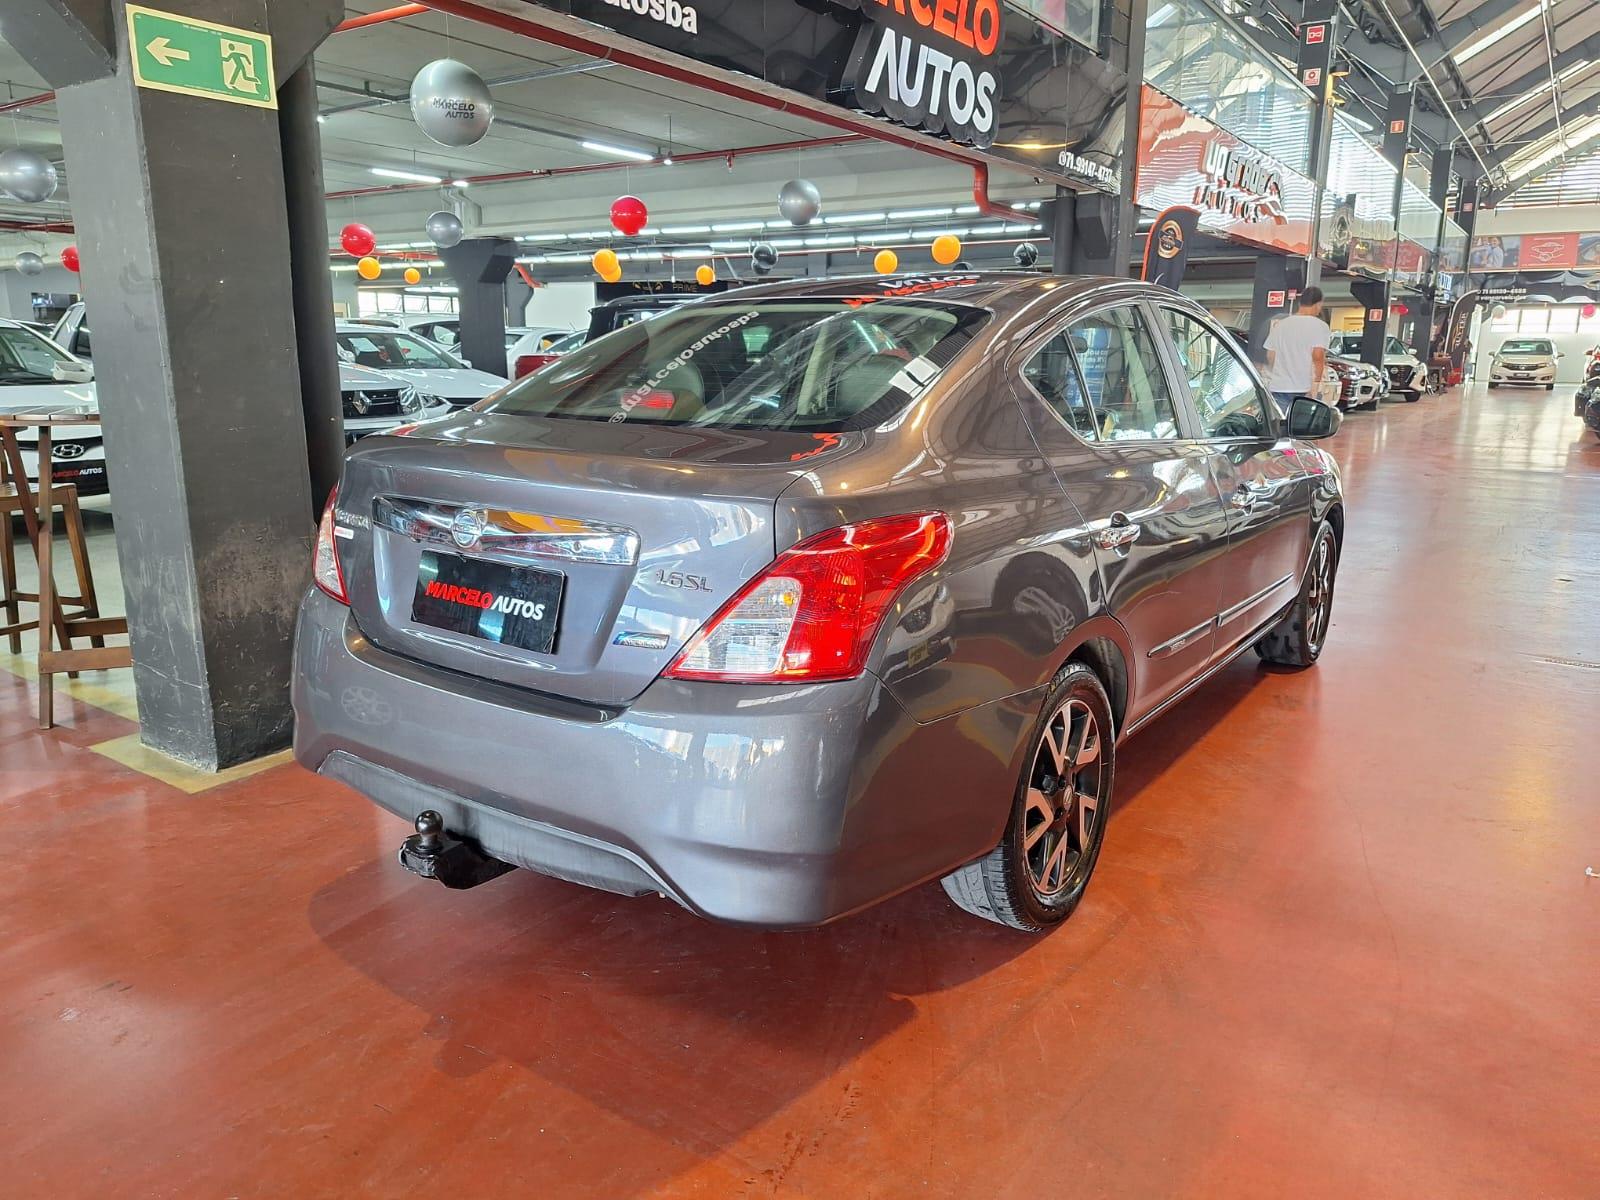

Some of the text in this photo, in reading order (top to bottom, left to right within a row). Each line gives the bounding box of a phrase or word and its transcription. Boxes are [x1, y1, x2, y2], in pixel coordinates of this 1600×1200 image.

[864, 27, 997, 133] AUTOS
[433, 98, 475, 112] MARCELO
[444, 111, 475, 119] AUTOS
